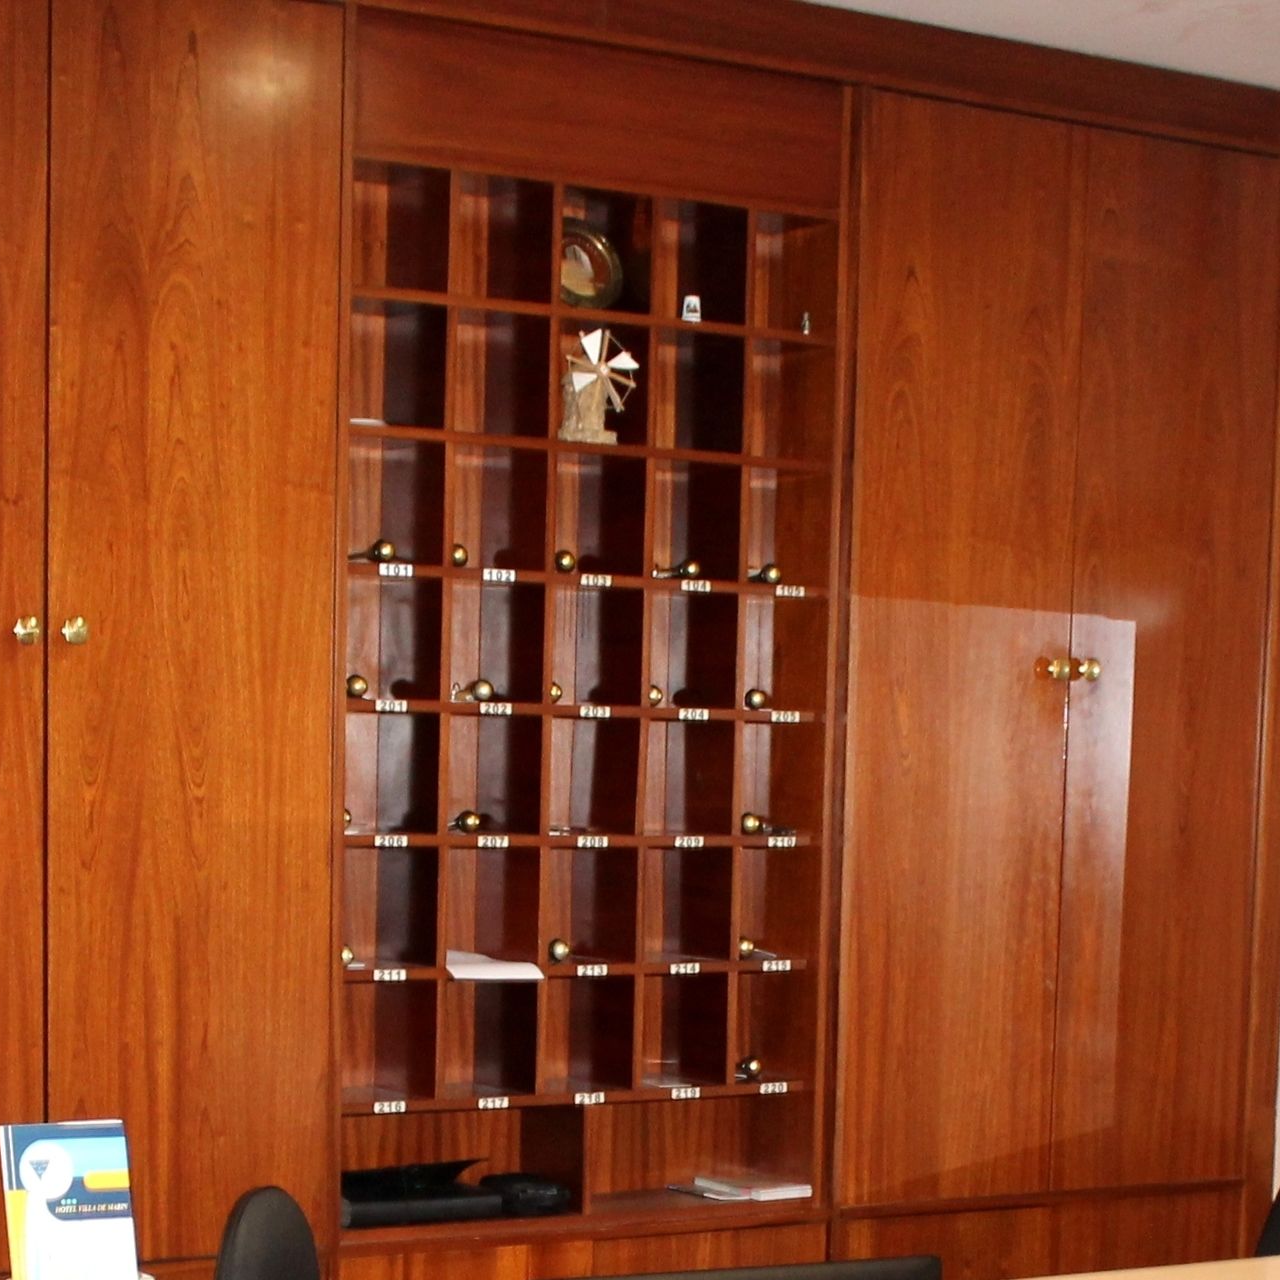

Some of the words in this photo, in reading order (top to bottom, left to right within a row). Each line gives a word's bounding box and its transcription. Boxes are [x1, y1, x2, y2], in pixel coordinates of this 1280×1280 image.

[384, 565, 410, 576] 101
[487, 571, 512, 581] 102
[585, 575, 608, 586] 103
[685, 581, 708, 592] 104
[381, 700, 404, 711] 201
[484, 703, 508, 714] 202
[584, 706, 607, 717] 203
[683, 709, 705, 720] 204
[775, 711, 797, 722] 205
[379, 836, 404, 846] 206
[482, 836, 506, 847] 207
[582, 836, 604, 847] 208
[679, 836, 701, 847] 209
[772, 837, 793, 847] 210
[581, 965, 604, 976] 213
[674, 963, 696, 974] 214
[378, 970, 402, 980] 211
[675, 1087, 697, 1098] 219
[763, 1083, 784, 1093] 220
[482, 1097, 505, 1108] 217
[578, 1093, 601, 1104] 218
[378, 1102, 402, 1112] 216
